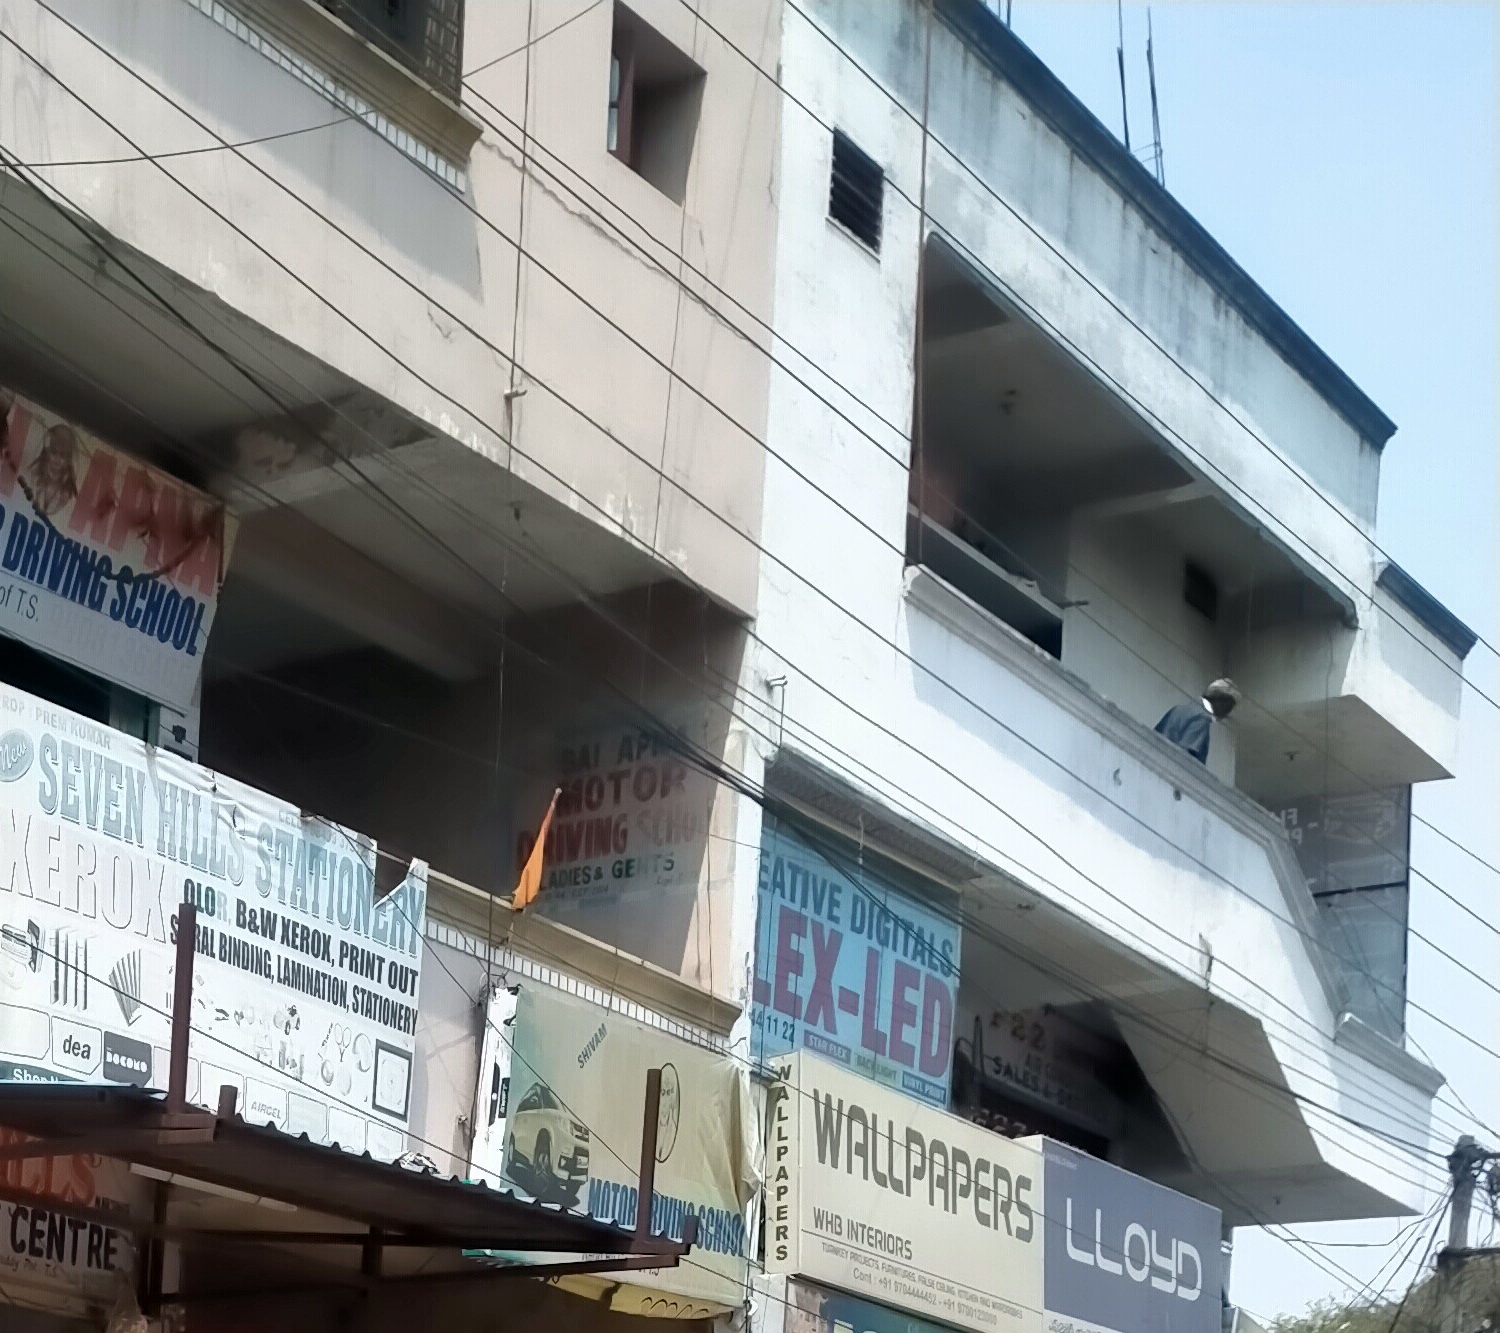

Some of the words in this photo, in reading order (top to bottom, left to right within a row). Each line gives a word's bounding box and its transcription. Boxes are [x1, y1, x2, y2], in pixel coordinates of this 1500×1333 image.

[2, 511, 110, 609] DRIVING
[111, 565, 205, 656] SCHOOL
[35, 707, 67, 734] PREM
[70, 716, 111, 750] KUMAR
[38, 731, 147, 848] SEVEN
[156, 778, 246, 887] HILLS
[555, 764, 688, 817] MOTOR
[235, 899, 278, 941] B&W
[280, 921, 335, 967] XEROX,
[339, 939, 386, 985] PRINT
[388, 959, 419, 998] OUT
[850, 892, 955, 979] DIGITALS
[218, 933, 275, 985] BINDING,
[276, 953, 350, 1014] LAMINATION,
[351, 984, 419, 1038] STATIONERY
[105, 1049, 149, 1074] DOCOMO
[577, 1022, 609, 1070] SHIVAM
[250, 1100, 282, 1120] AIRCEL
[775, 1063, 792, 1262] WALLPAPERS
[813, 1087, 1035, 1244] WALLPAPERS
[8, 1200, 119, 1272] CENTRE
[813, 1206, 843, 1237] WHB
[847, 1218, 913, 1261] INTERIORS
[1066, 1197, 1202, 1301] LLOYD
